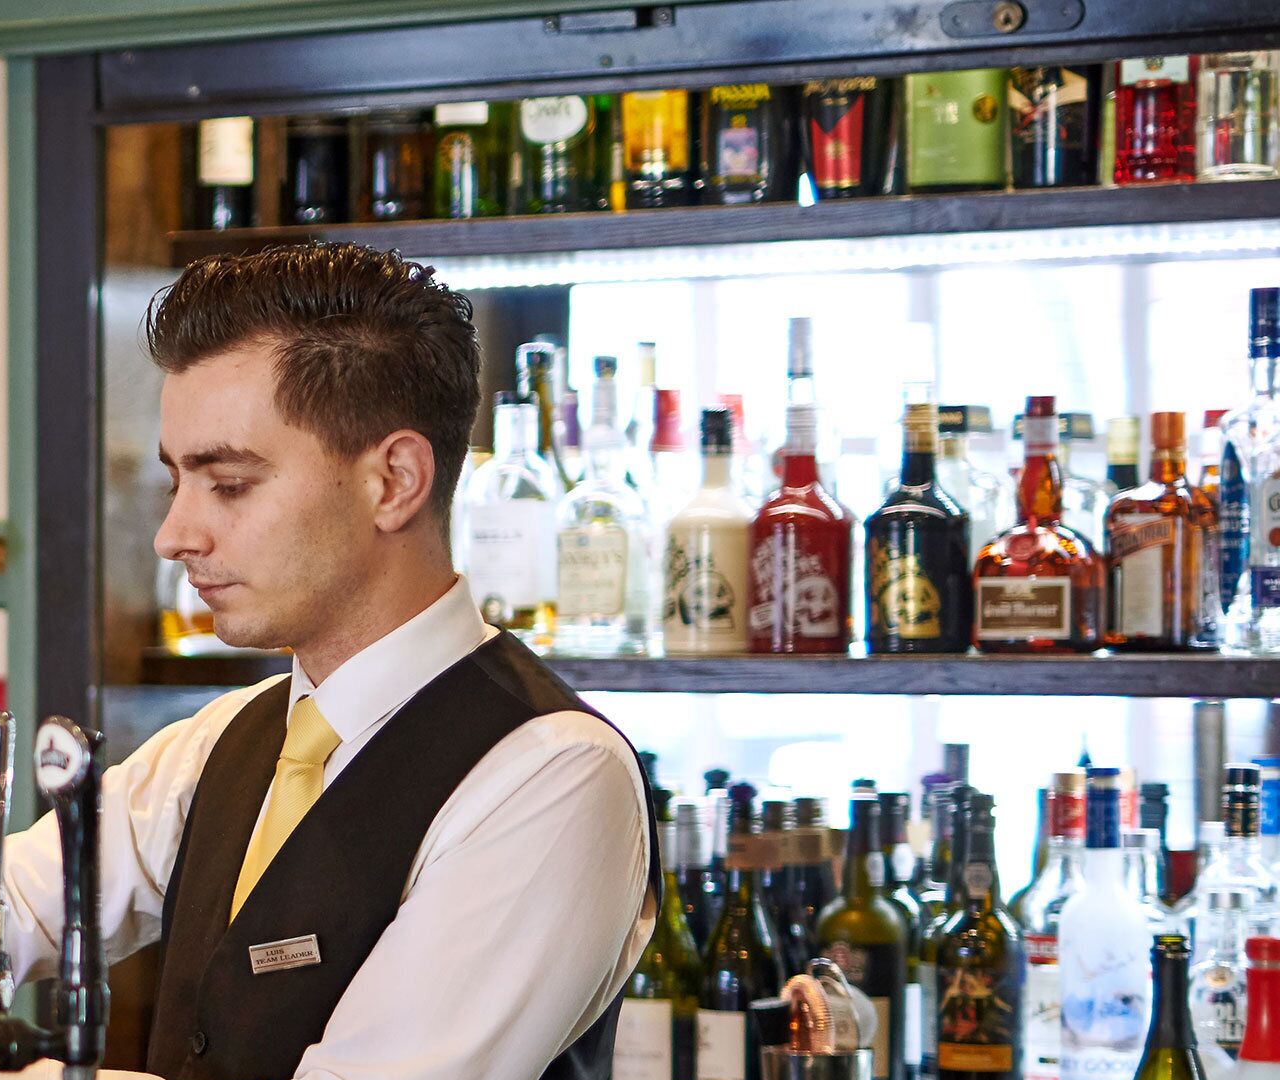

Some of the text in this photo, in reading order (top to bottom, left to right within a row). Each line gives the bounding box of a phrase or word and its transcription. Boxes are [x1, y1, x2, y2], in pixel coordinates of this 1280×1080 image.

[256, 950, 313, 965] TEAM LEADER
[265, 948, 285, 957] LUIS
